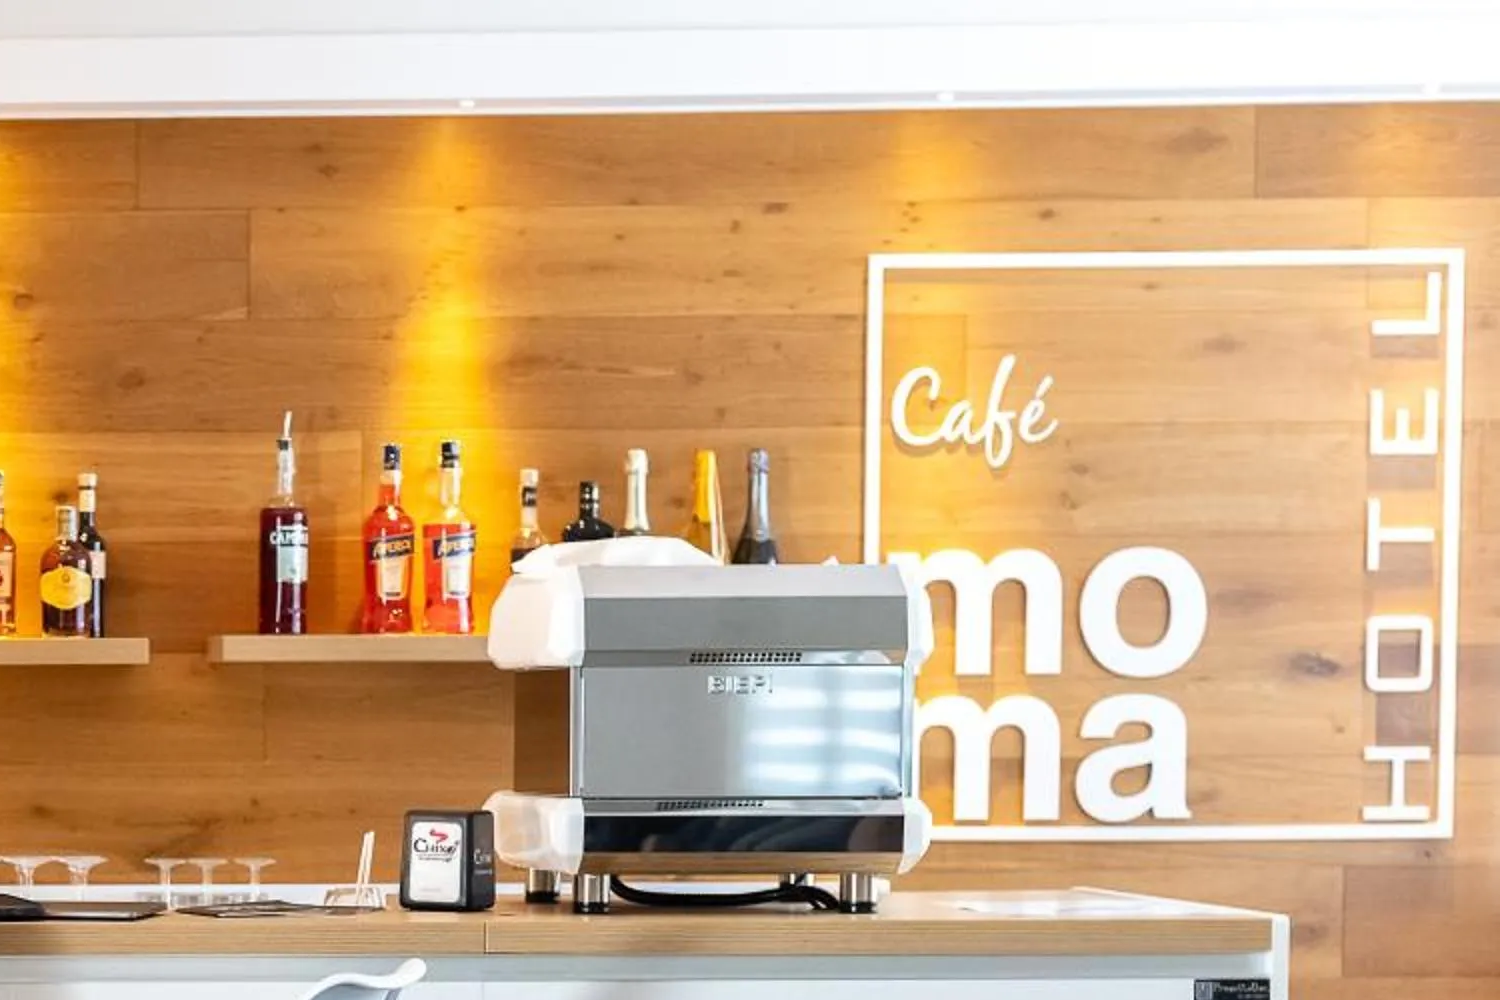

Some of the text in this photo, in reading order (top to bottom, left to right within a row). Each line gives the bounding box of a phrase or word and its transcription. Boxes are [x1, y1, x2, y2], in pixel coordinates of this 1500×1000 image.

[891, 354, 1059, 468] Café
[269, 530, 309, 546] CAMPI
[437, 538, 475, 557] APE
[1362, 271, 1443, 822] HOTEL
[888, 546, 1208, 678] mo
[912, 693, 1192, 823] ma
